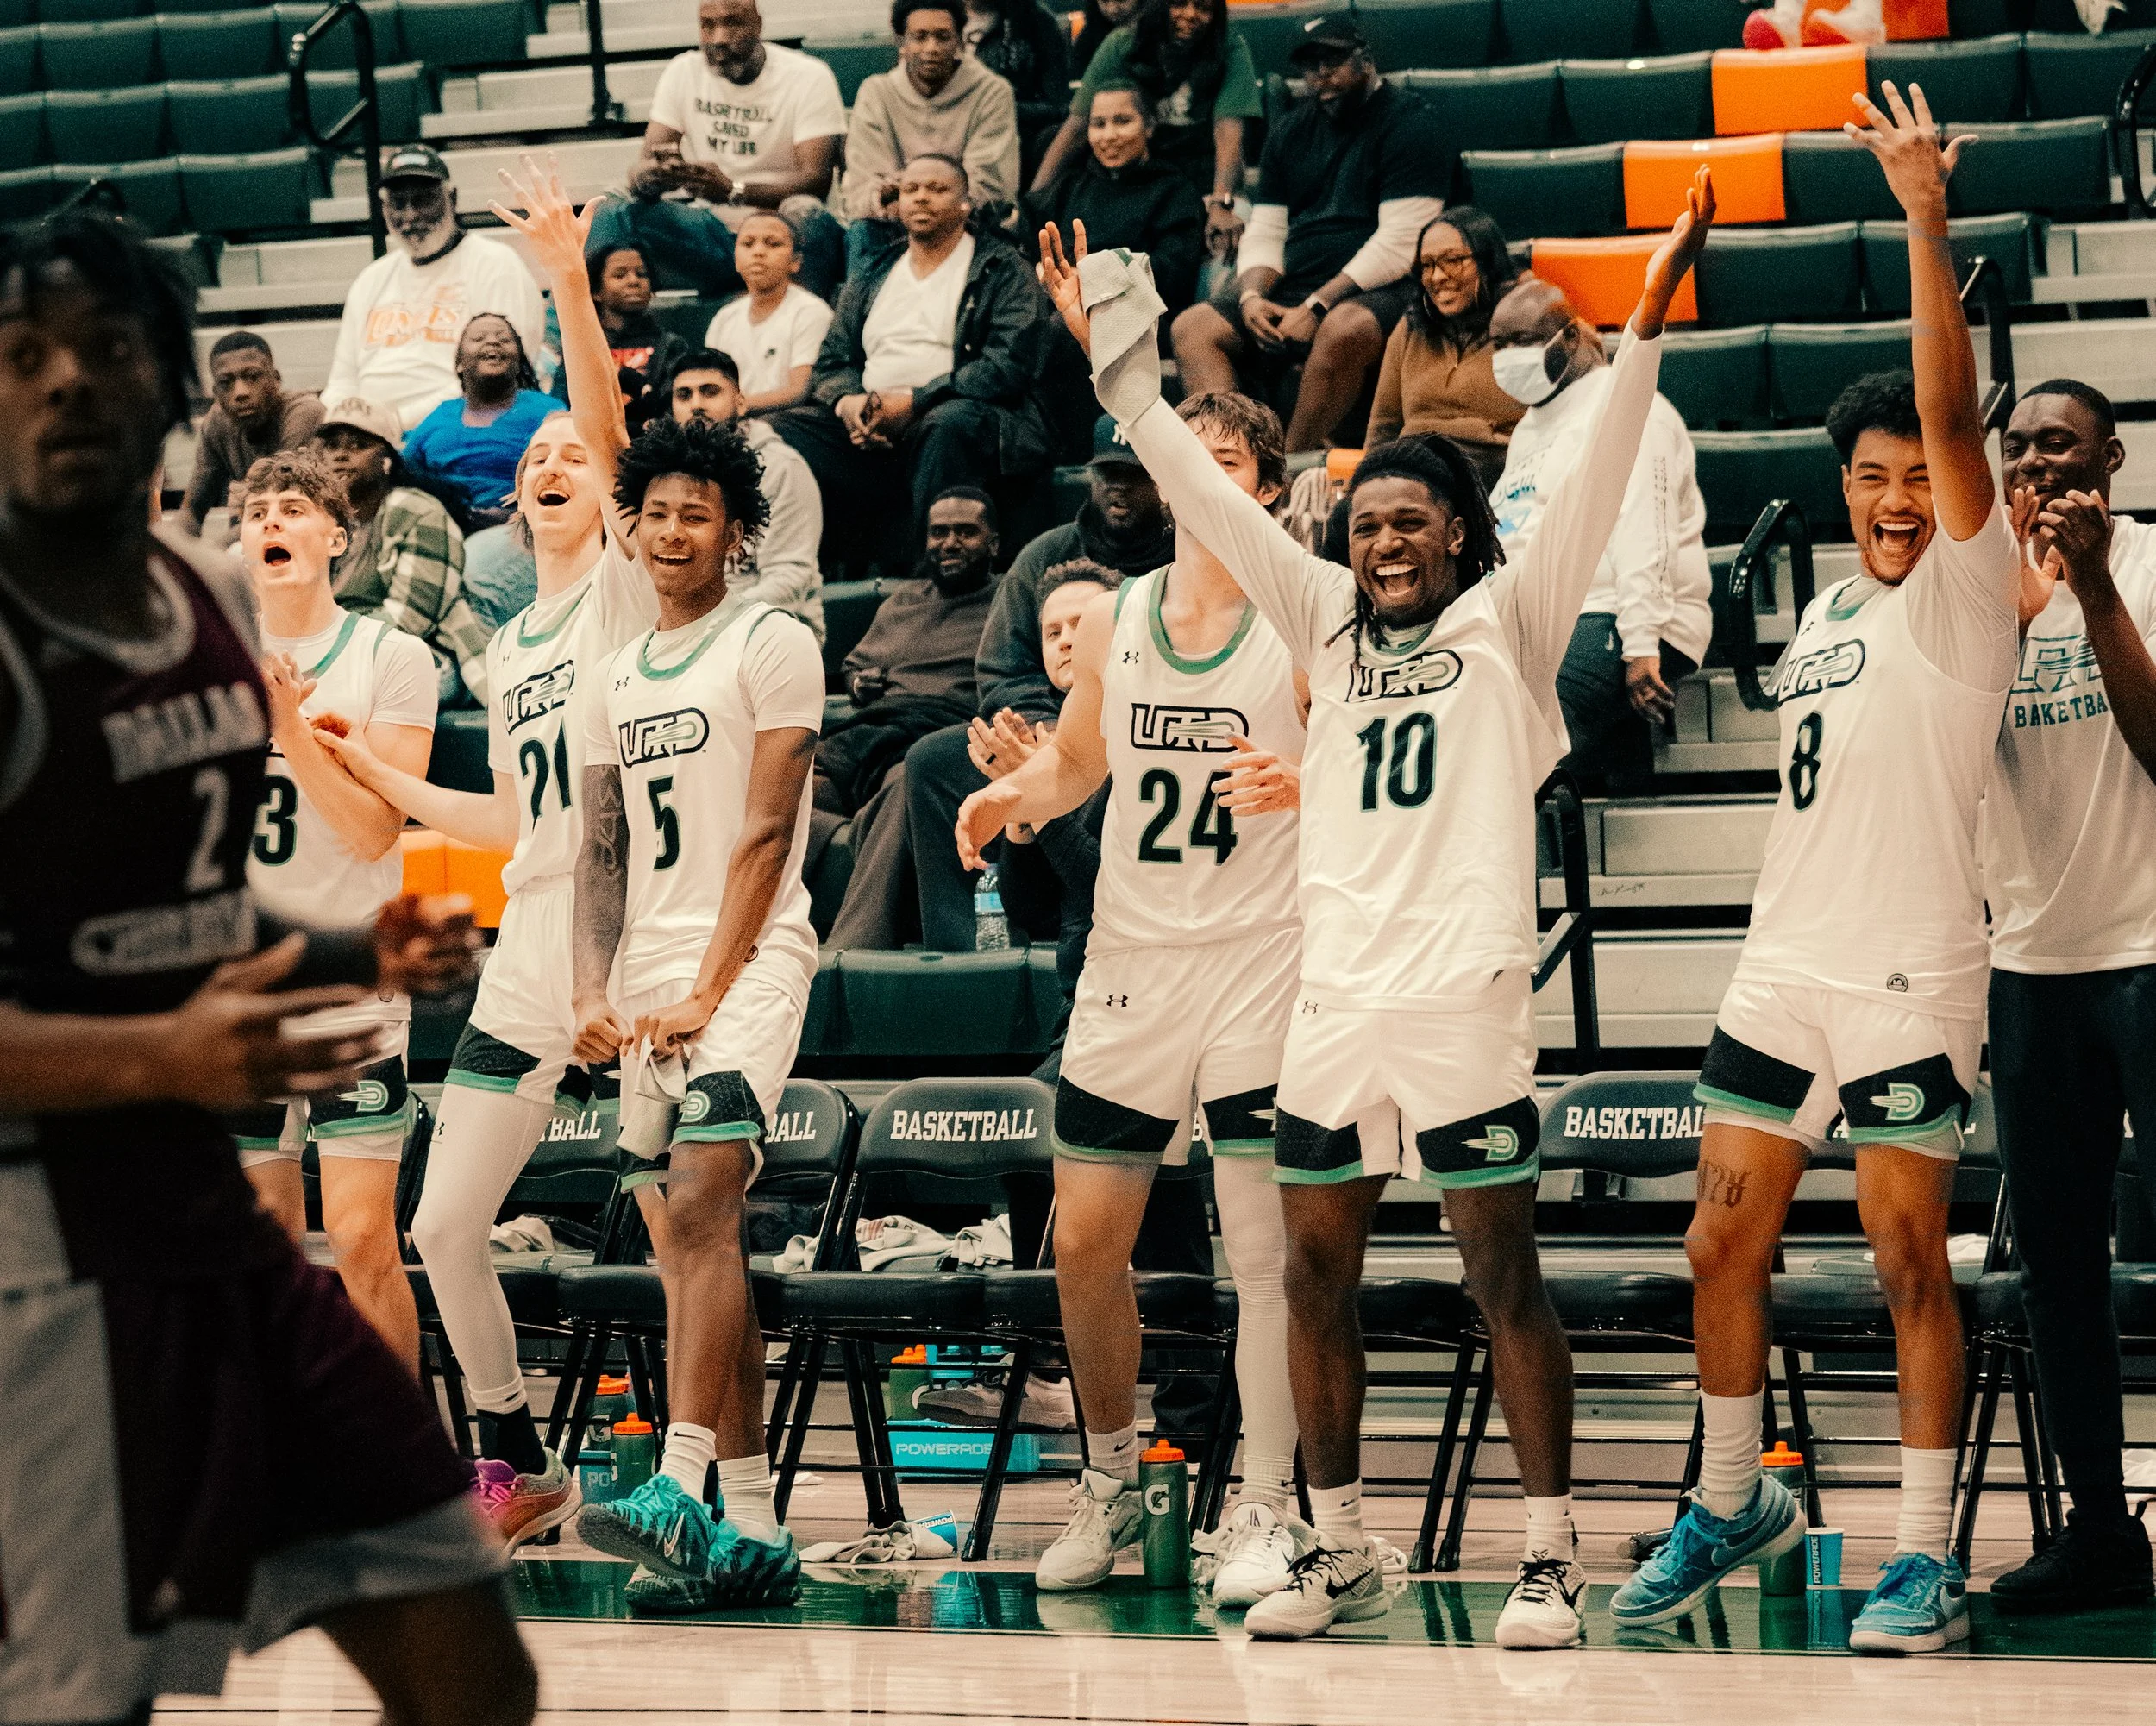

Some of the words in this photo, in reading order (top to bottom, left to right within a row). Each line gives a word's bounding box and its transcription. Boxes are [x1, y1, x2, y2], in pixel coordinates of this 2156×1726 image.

[1344, 649, 1463, 702] UTD
[618, 706, 710, 769] UTD
[1131, 702, 1250, 753] UTD
[518, 715, 573, 836] 21
[1355, 710, 1438, 813] 10
[1788, 709, 1824, 813] 8
[647, 773, 681, 873] 5
[1137, 766, 1239, 866] 24
[890, 1108, 1037, 1142] BASKETBALL
[1144, 1483, 1170, 1516] G
[1811, 1535, 1821, 1585] POWERADE
